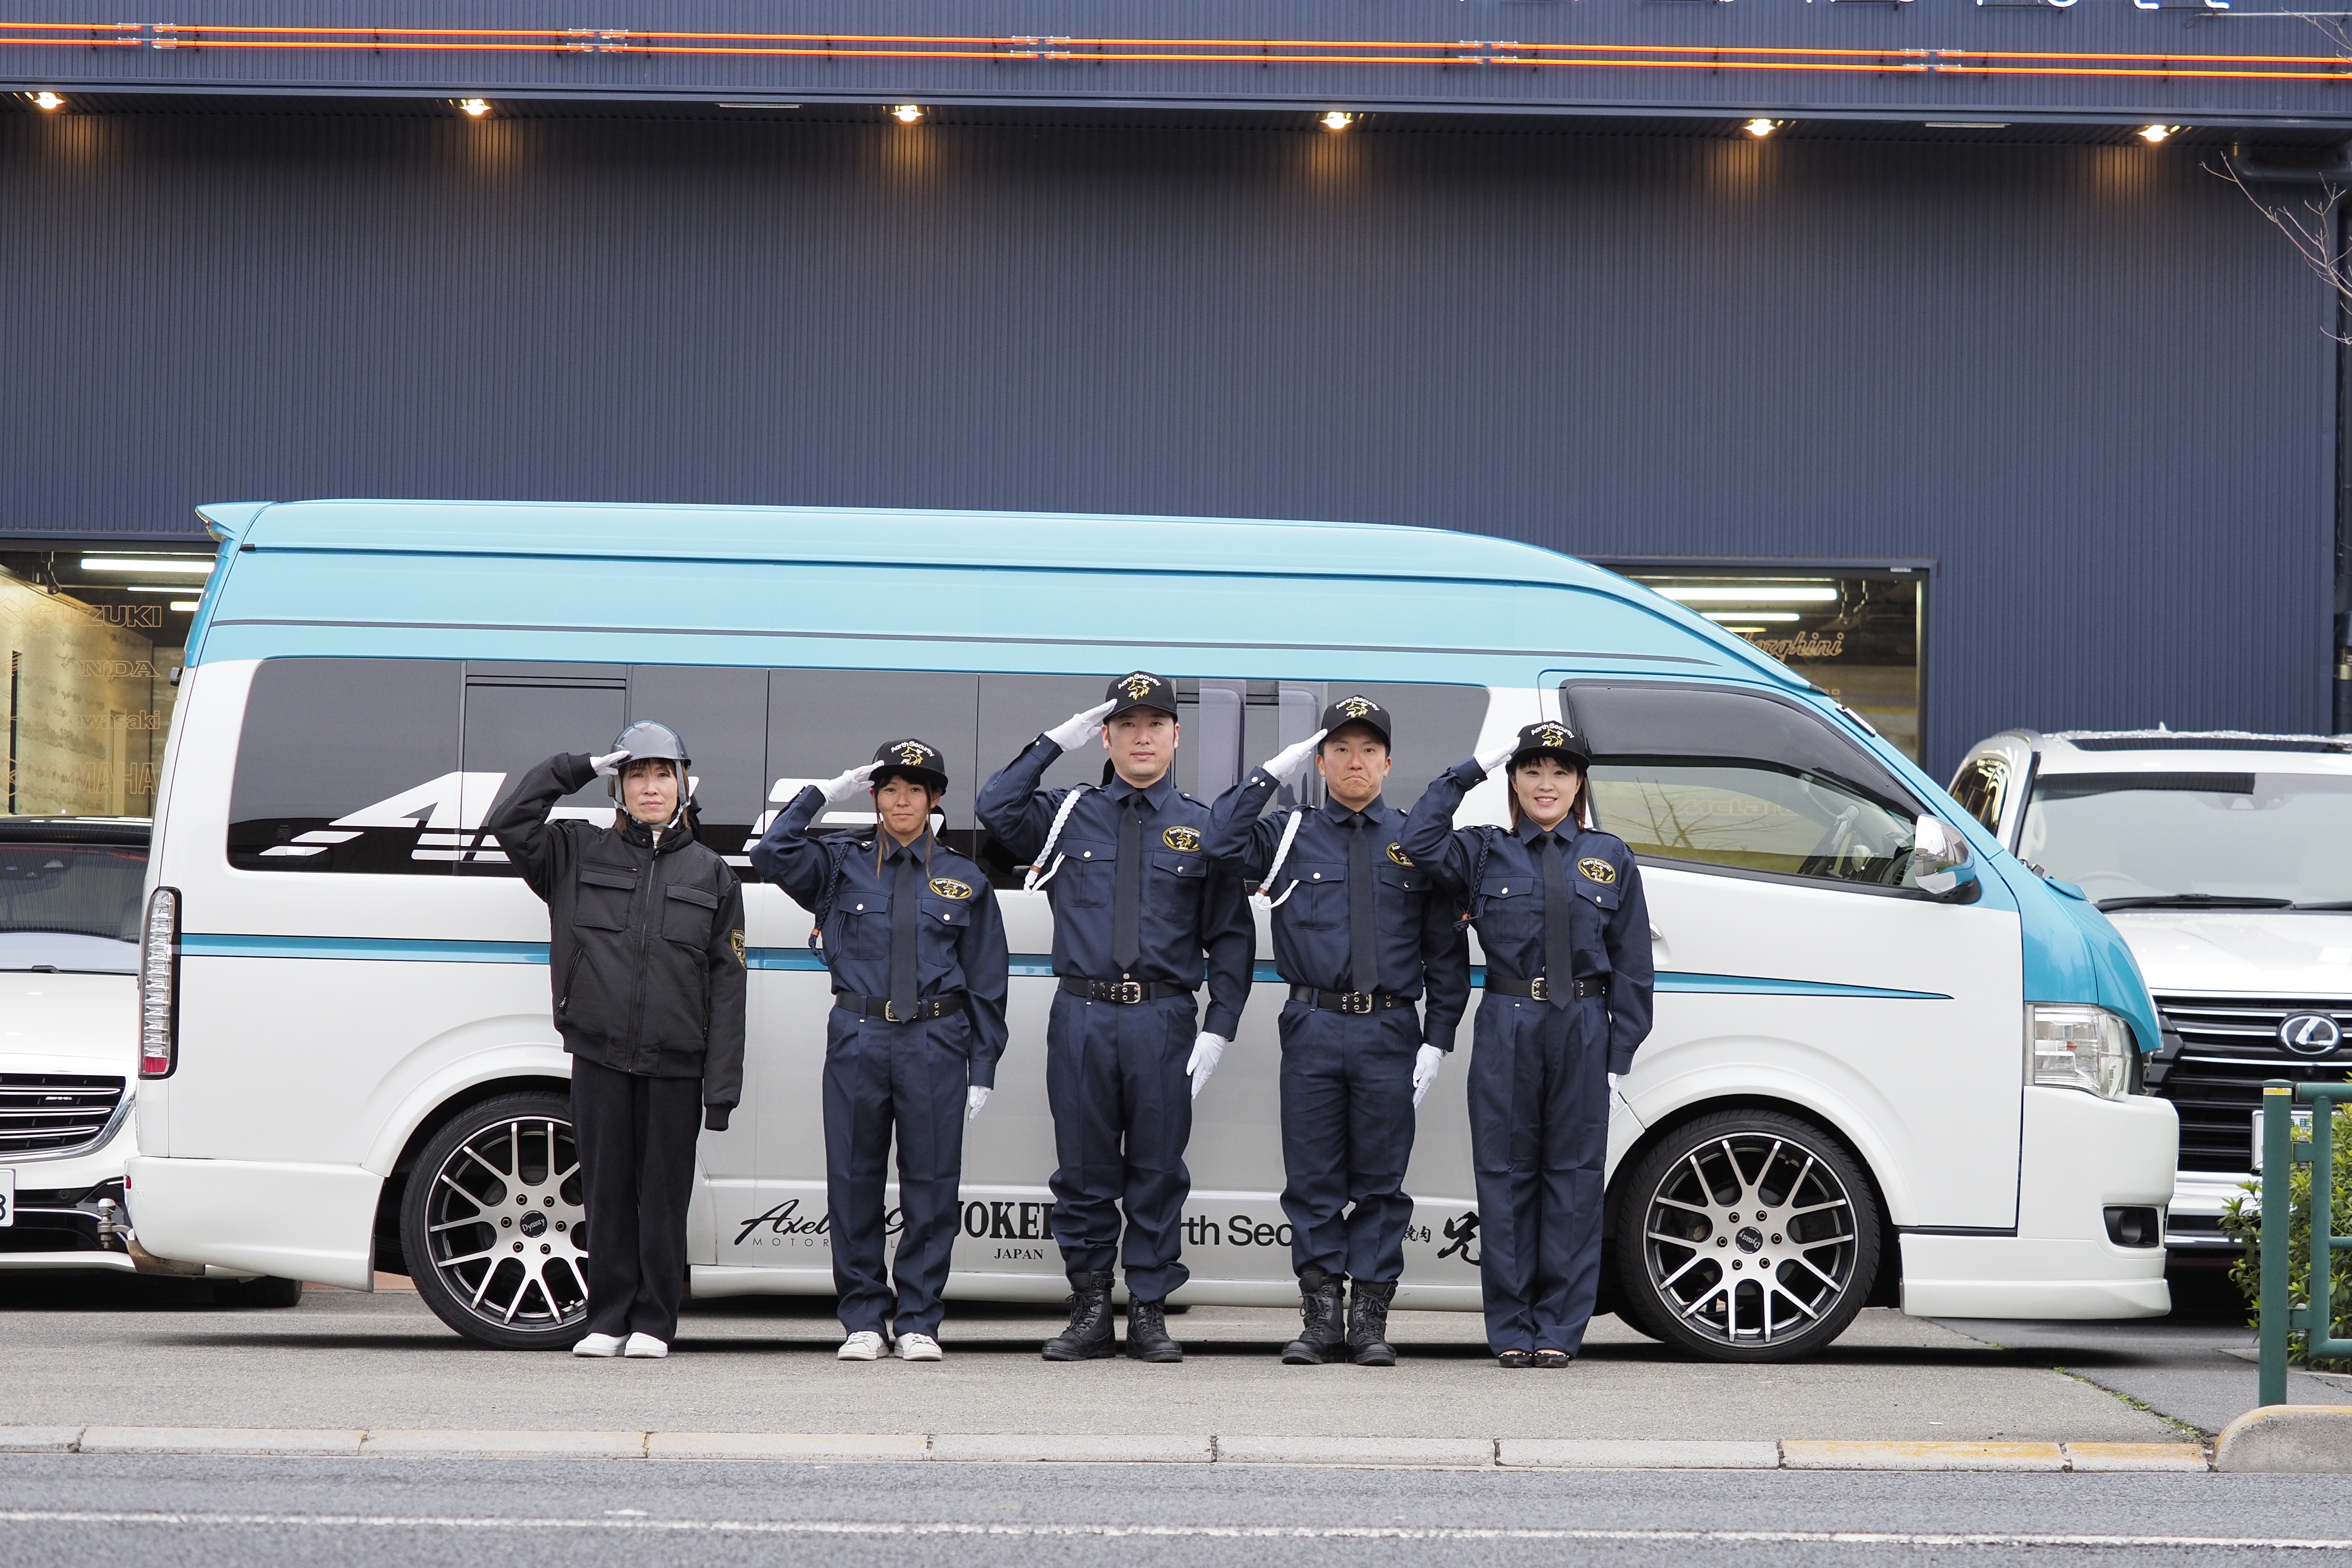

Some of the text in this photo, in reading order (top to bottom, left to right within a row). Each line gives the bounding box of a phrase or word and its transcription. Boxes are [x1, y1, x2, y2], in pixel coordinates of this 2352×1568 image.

[30, 604, 162, 627] SUZUKI
[33, 661, 160, 677] ONDA
[1134, 673, 1161, 686] Security
[1353, 696, 1380, 710] Security
[54, 710, 160, 729] wasaki
[1549, 723, 1575, 738] Security
[909, 741, 935, 757] Security
[36, 763, 159, 794] MAHA
[522, 1219, 544, 1232] Dynasty
[1738, 1231, 1761, 1249] Dynasty
[994, 1248, 1044, 1260] JAPAN
